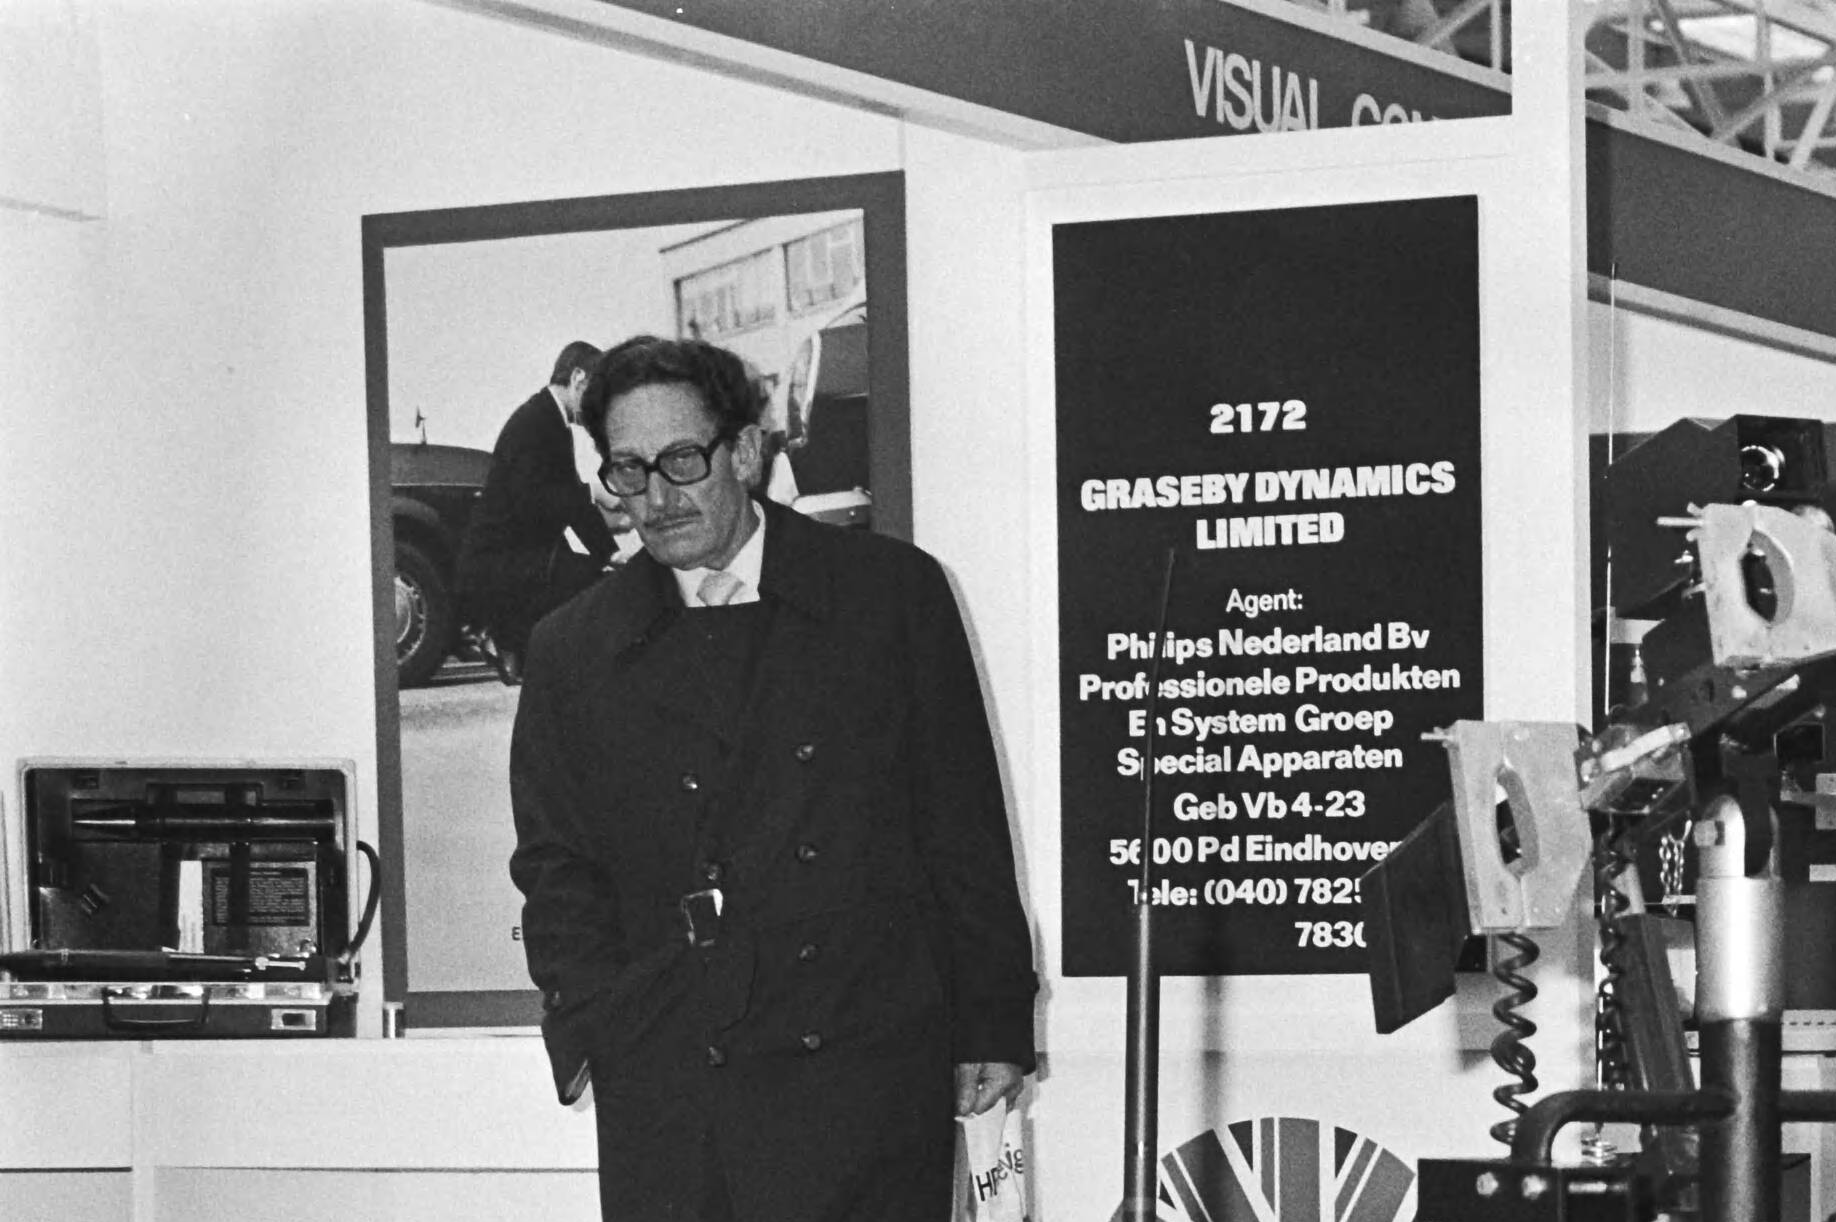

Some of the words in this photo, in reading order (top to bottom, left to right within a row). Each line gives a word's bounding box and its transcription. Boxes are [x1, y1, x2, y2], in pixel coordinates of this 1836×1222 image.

[1209, 399, 1307, 434] 2172
[1080, 472, 1250, 512] GRASEBY
[1254, 460, 1456, 503] DYNAMICS
[1196, 511, 1345, 550] LIMITED
[1225, 588, 1303, 619] Agent:
[1218, 622, 1382, 656] Nederland
[1387, 621, 1431, 650] Bv
[1295, 662, 1461, 694] Produkten
[1170, 707, 1287, 742] System
[1294, 703, 1394, 737] Groep
[1116, 744, 1233, 782] Secial
[1236, 734, 1404, 779] Apparaten
[1173, 792, 1238, 822] Geb
[1241, 791, 1288, 820] Vb
[1290, 789, 1366, 818] 4-23
[1197, 835, 1240, 863] Pd
[1203, 877, 1288, 906] (040)
